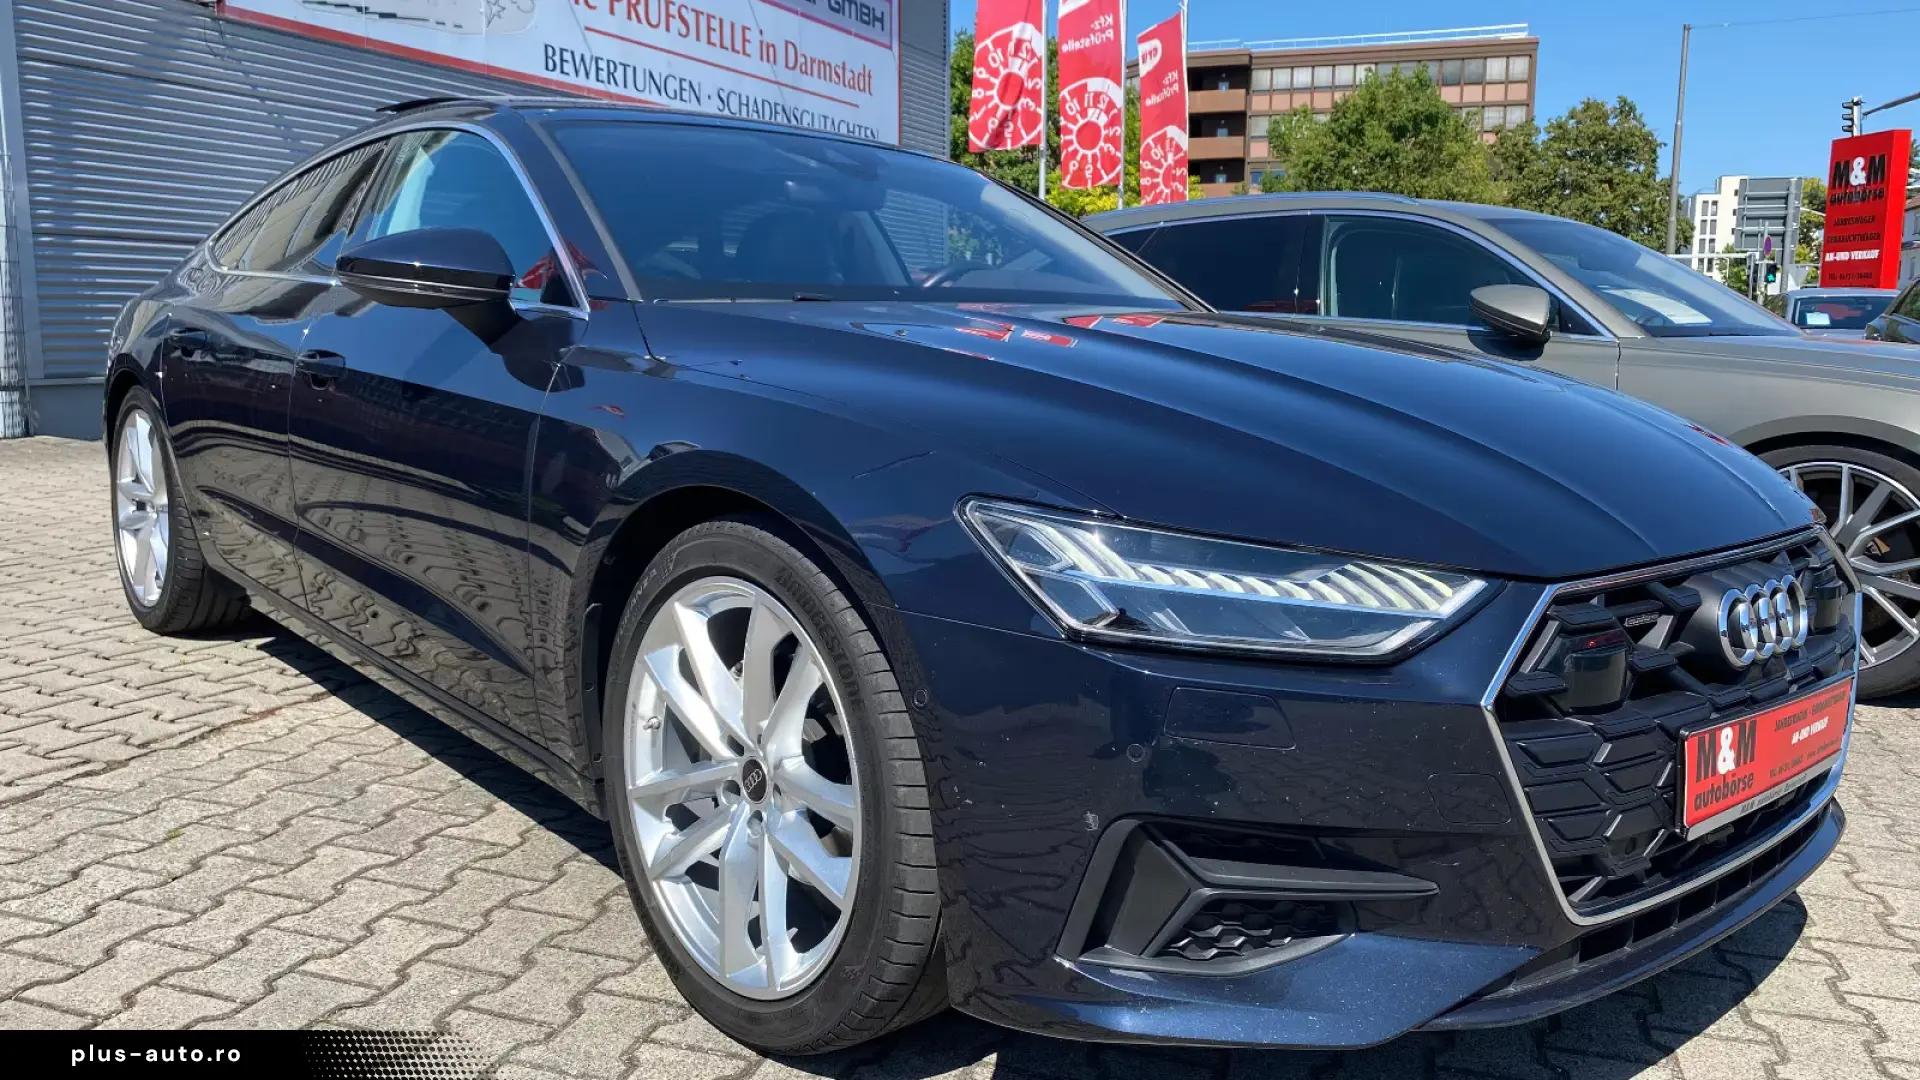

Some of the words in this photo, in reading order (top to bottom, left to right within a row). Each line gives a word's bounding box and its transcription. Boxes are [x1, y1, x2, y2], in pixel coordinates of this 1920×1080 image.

[543, 43, 701, 106] BEWERTUNGEN
[758, 28, 777, 65] in
[784, 40, 873, 96] Darmstadt
[1832, 154, 1886, 189] M&M
[1696, 719, 1757, 783] M&M
[1694, 772, 1754, 811] autobörse
